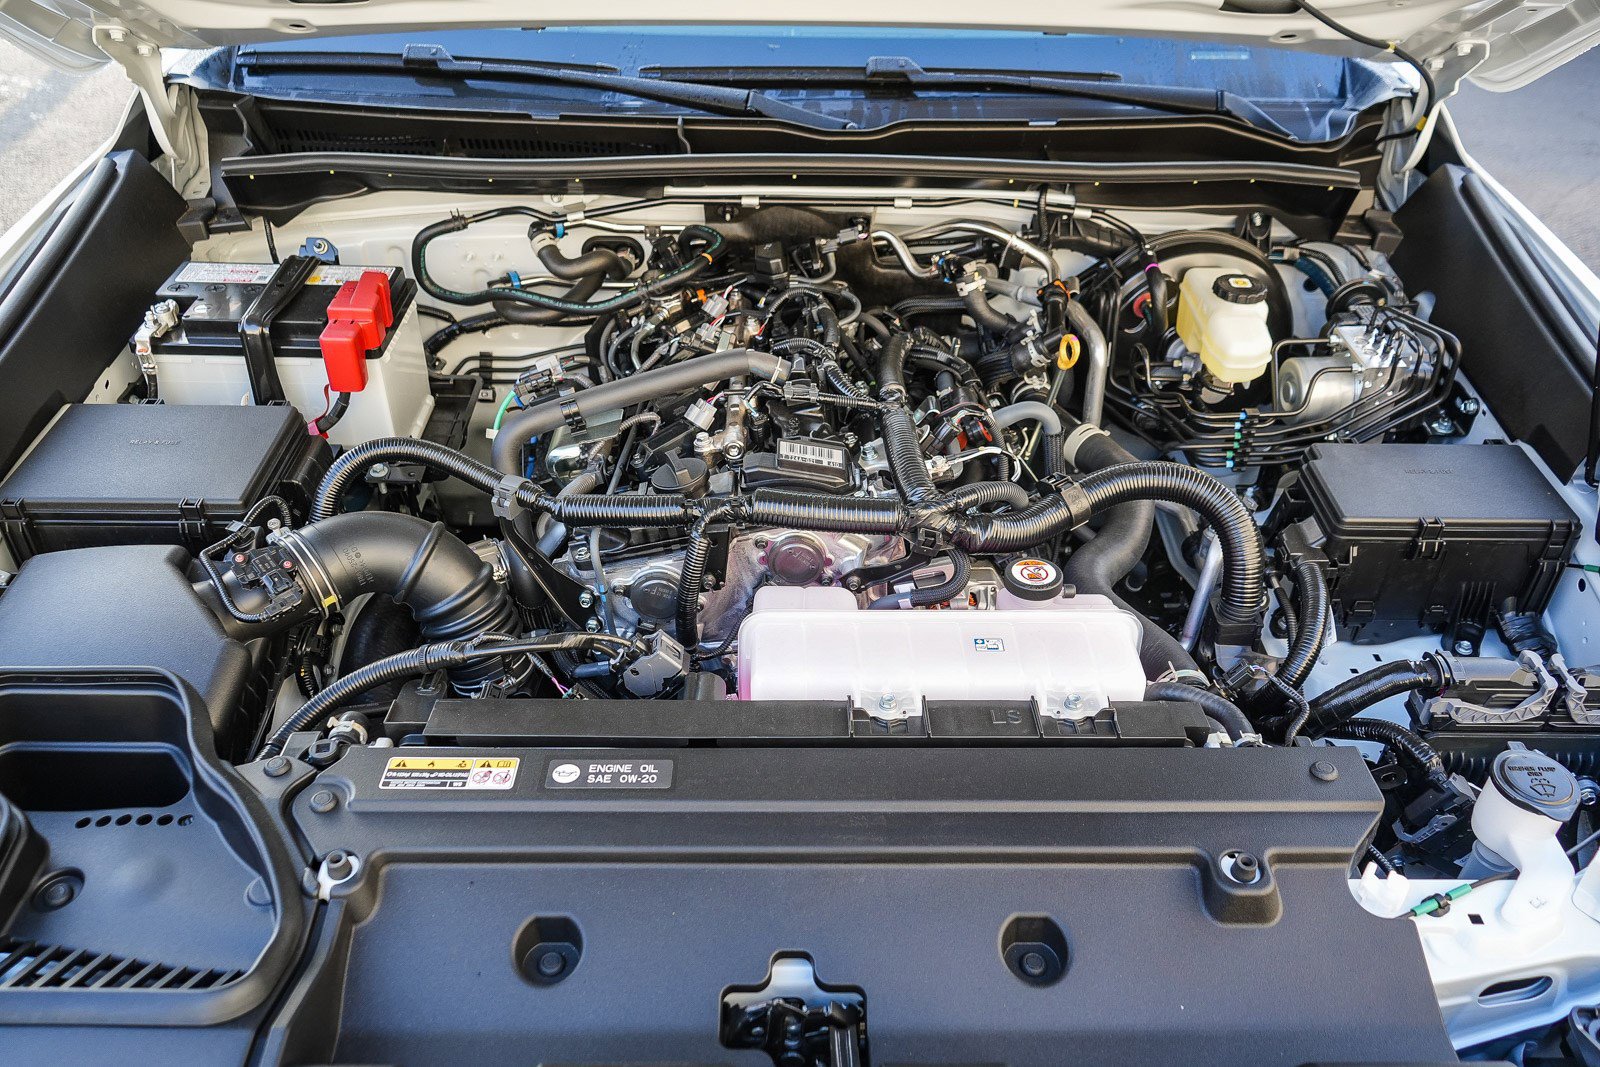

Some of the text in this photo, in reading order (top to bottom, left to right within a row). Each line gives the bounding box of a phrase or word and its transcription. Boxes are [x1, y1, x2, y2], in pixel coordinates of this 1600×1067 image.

[990, 709, 1022, 724] LS
[588, 764, 659, 773] ENGINE OIL
[586, 774, 658, 783] SAE 0W-20
